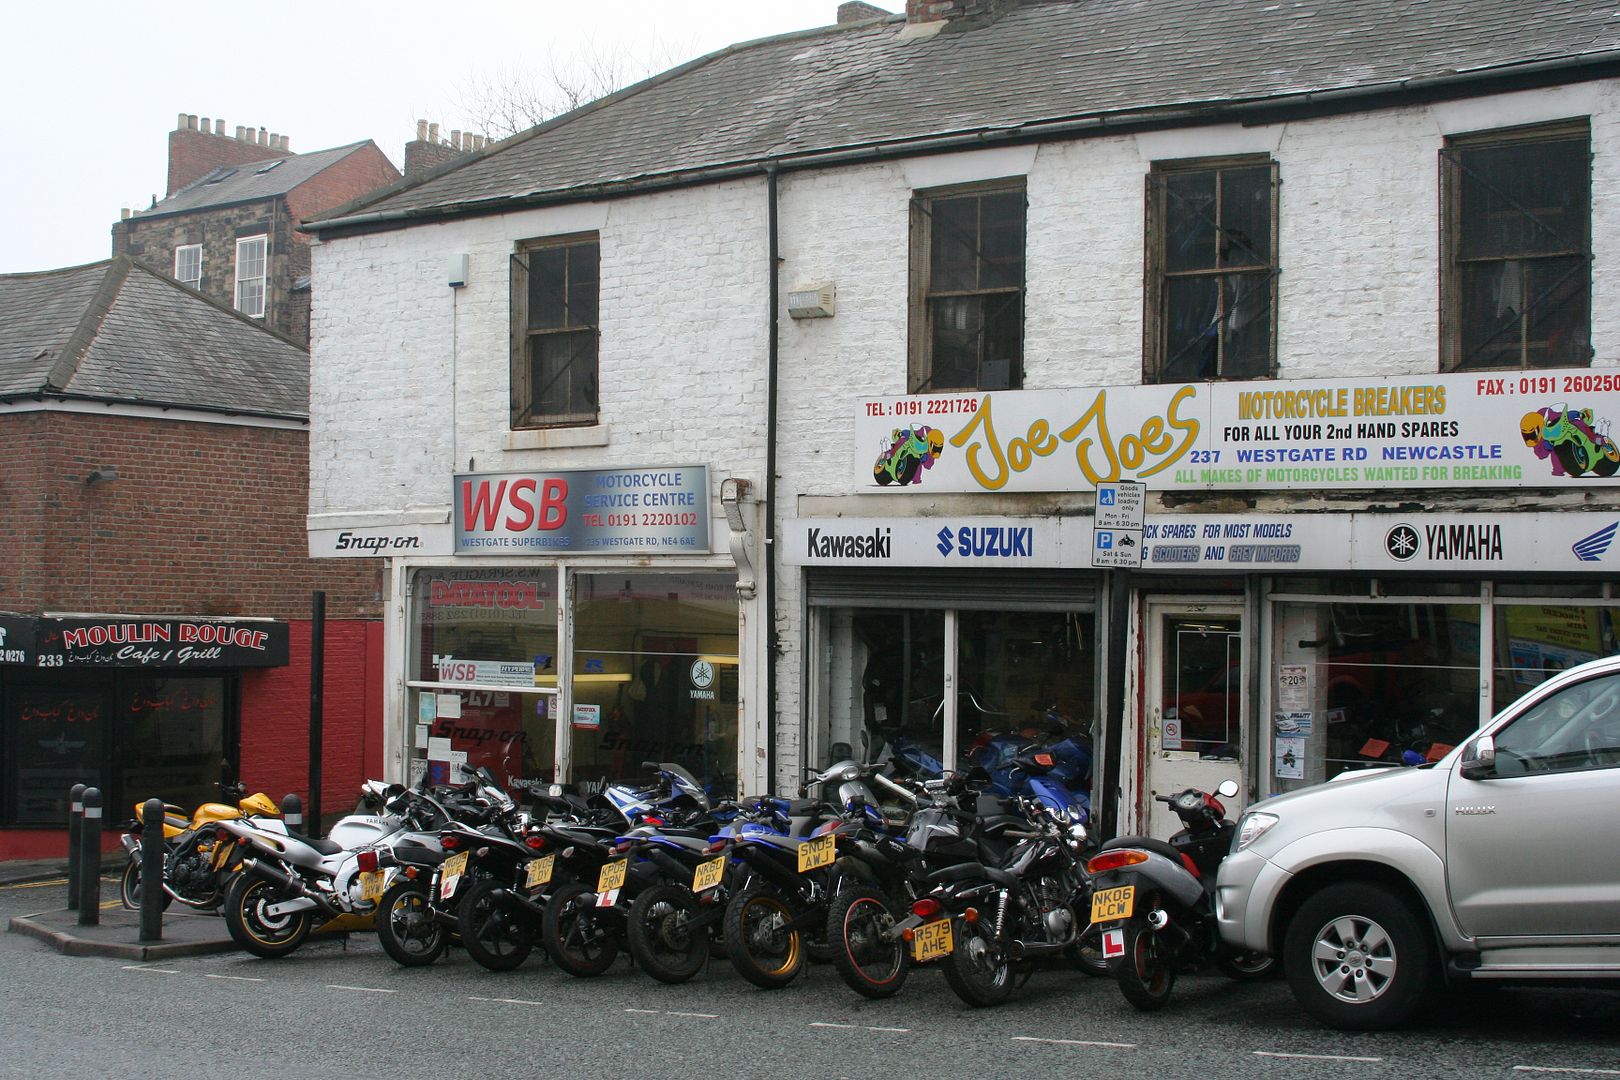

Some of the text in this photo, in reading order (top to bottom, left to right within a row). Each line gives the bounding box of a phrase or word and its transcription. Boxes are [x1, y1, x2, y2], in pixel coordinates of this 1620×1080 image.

[1519, 377, 1556, 394] 0191
[895, 401, 922, 415] 0191
[927, 398, 978, 414] 2221726
[1238, 385, 1447, 420] MOTORCYCLE BREAKERS
[1224, 421, 1459, 442] FOR ALL YOUR 2nd HAND SPARES
[950, 394, 1059, 490] Joe
[1190, 445, 1502, 463] 237 WESTGATE RD NEWCASTLE
[596, 472, 682, 488] MOTORCYCLE
[1175, 465, 1522, 483] ALL MAKES OF MOTORCYCLES WANTED FOR BREAKING
[462, 478, 569, 532] WSB
[584, 493, 695, 508] SERVICE CENTRE
[584, 513, 697, 527] TEL 0191 2220102
[1161, 524, 1197, 538] SPARES
[1203, 524, 1221, 538] FOR
[1223, 524, 1251, 538] MOST
[1253, 523, 1292, 538] MODELS
[336, 532, 419, 554] Snap-on
[461, 536, 571, 547] WESTGATE SUPERBIKES
[602, 537, 644, 546] WESTGATE
[662, 536, 678, 545] NE4
[679, 536, 696, 545] 6AE
[807, 528, 891, 558] Kawasaki
[958, 527, 1033, 557] SUZUKI
[1425, 524, 1503, 560] YAMAHA
[1152, 545, 1200, 562] SCOOTERS
[1204, 546, 1225, 560] AND
[1229, 545, 1254, 562] GREY
[1255, 545, 1301, 562] IMPORTS
[430, 580, 545, 611] DATATOOL
[63, 623, 171, 650] MOULIN
[179, 623, 269, 650] ROUGE
[5, 649, 25, 663] 0276
[38, 654, 64, 667] 233
[117, 645, 162, 664] Cafe
[177, 646, 222, 664] Grill
[441, 663, 476, 681] WSB
[690, 690, 715, 700] YAMAHA
[1094, 889, 1132, 906] NK06
[1098, 902, 1127, 918] LCW
[916, 922, 950, 942] R579
[922, 937, 947, 955] AHE
[1104, 933, 1122, 955] L
